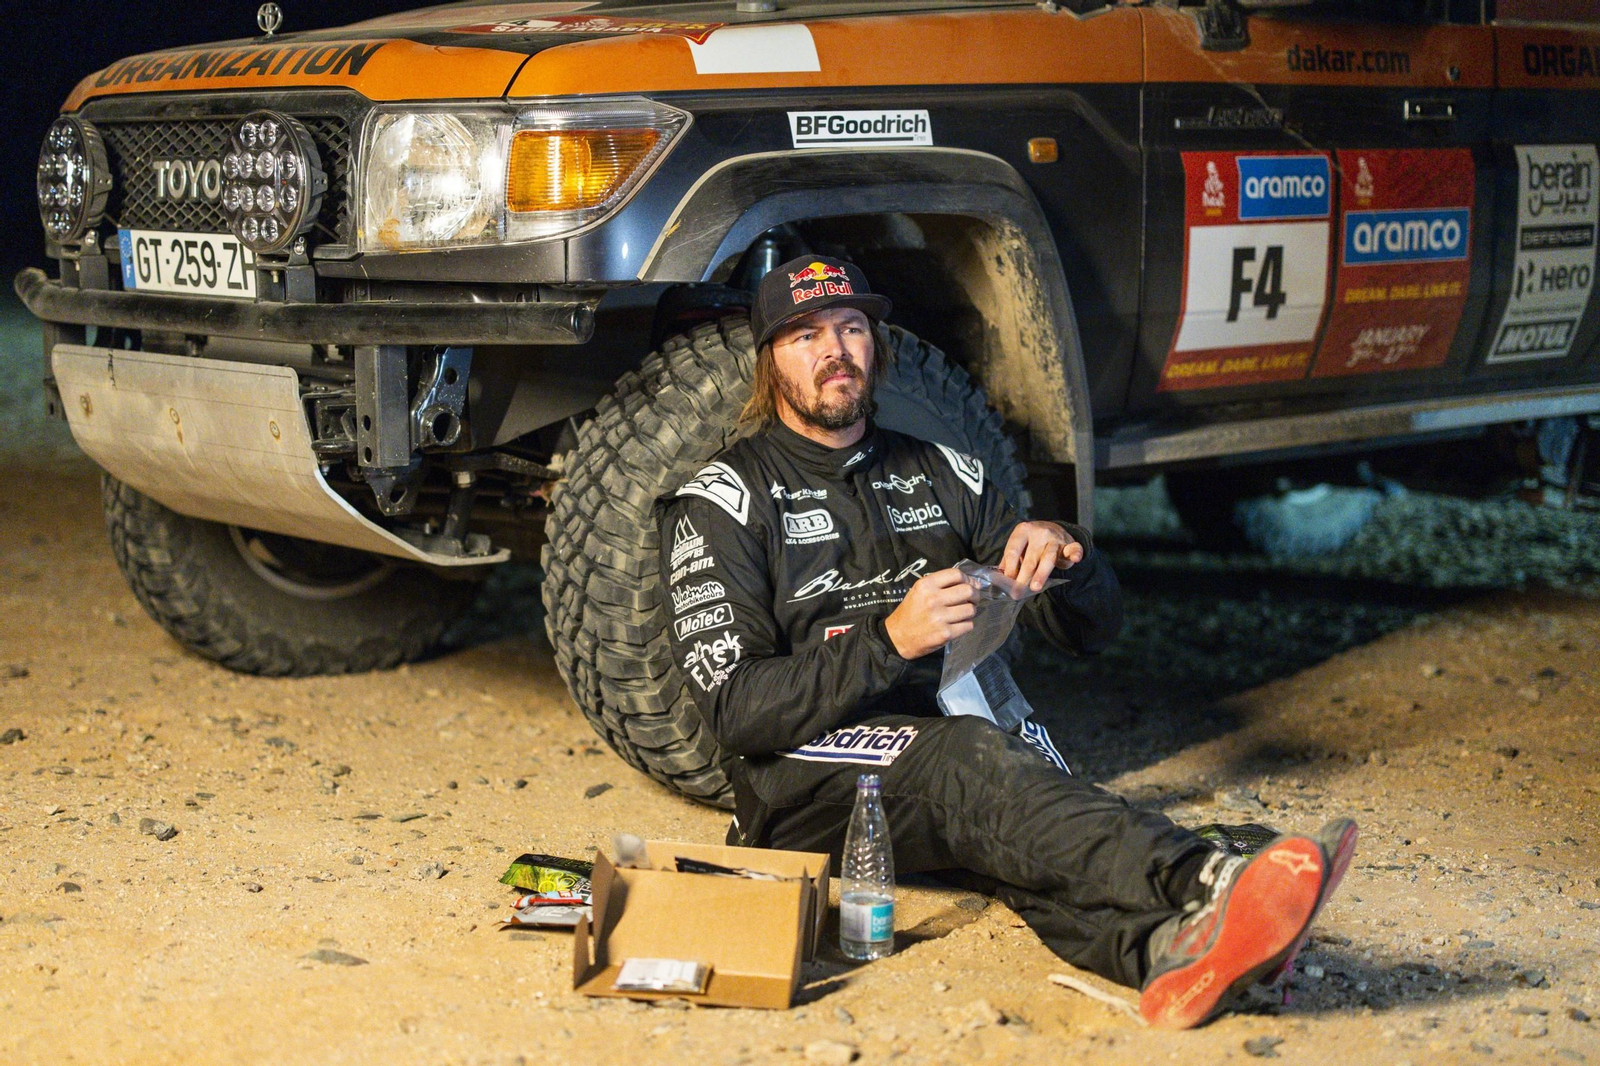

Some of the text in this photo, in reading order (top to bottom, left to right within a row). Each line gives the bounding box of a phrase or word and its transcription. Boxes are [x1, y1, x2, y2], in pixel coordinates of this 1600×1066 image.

[95, 43, 388, 88] ORGANIZATION
[1287, 44, 1410, 73] dakar.com
[796, 114, 927, 136] BFGoodrich
[153, 160, 220, 199] TOYO
[1527, 152, 1591, 189] berain
[1245, 175, 1325, 198] aramco
[1353, 218, 1461, 253] aramco
[1522, 229, 1591, 245] DEFENDER
[1226, 245, 1286, 323] F4
[1541, 263, 1590, 292] Hero
[792, 281, 854, 304] Red Bull
[1351, 324, 1430, 349] JANUARY
[1498, 322, 1571, 352] MOTUL
[787, 514, 828, 533] ARB
[892, 502, 943, 525] Scipio
[799, 532, 840, 544] ACCESSORIES
[672, 582, 724, 605] Vietnam
[843, 591, 877, 602] MOTOR
[680, 607, 725, 637] MoTeC
